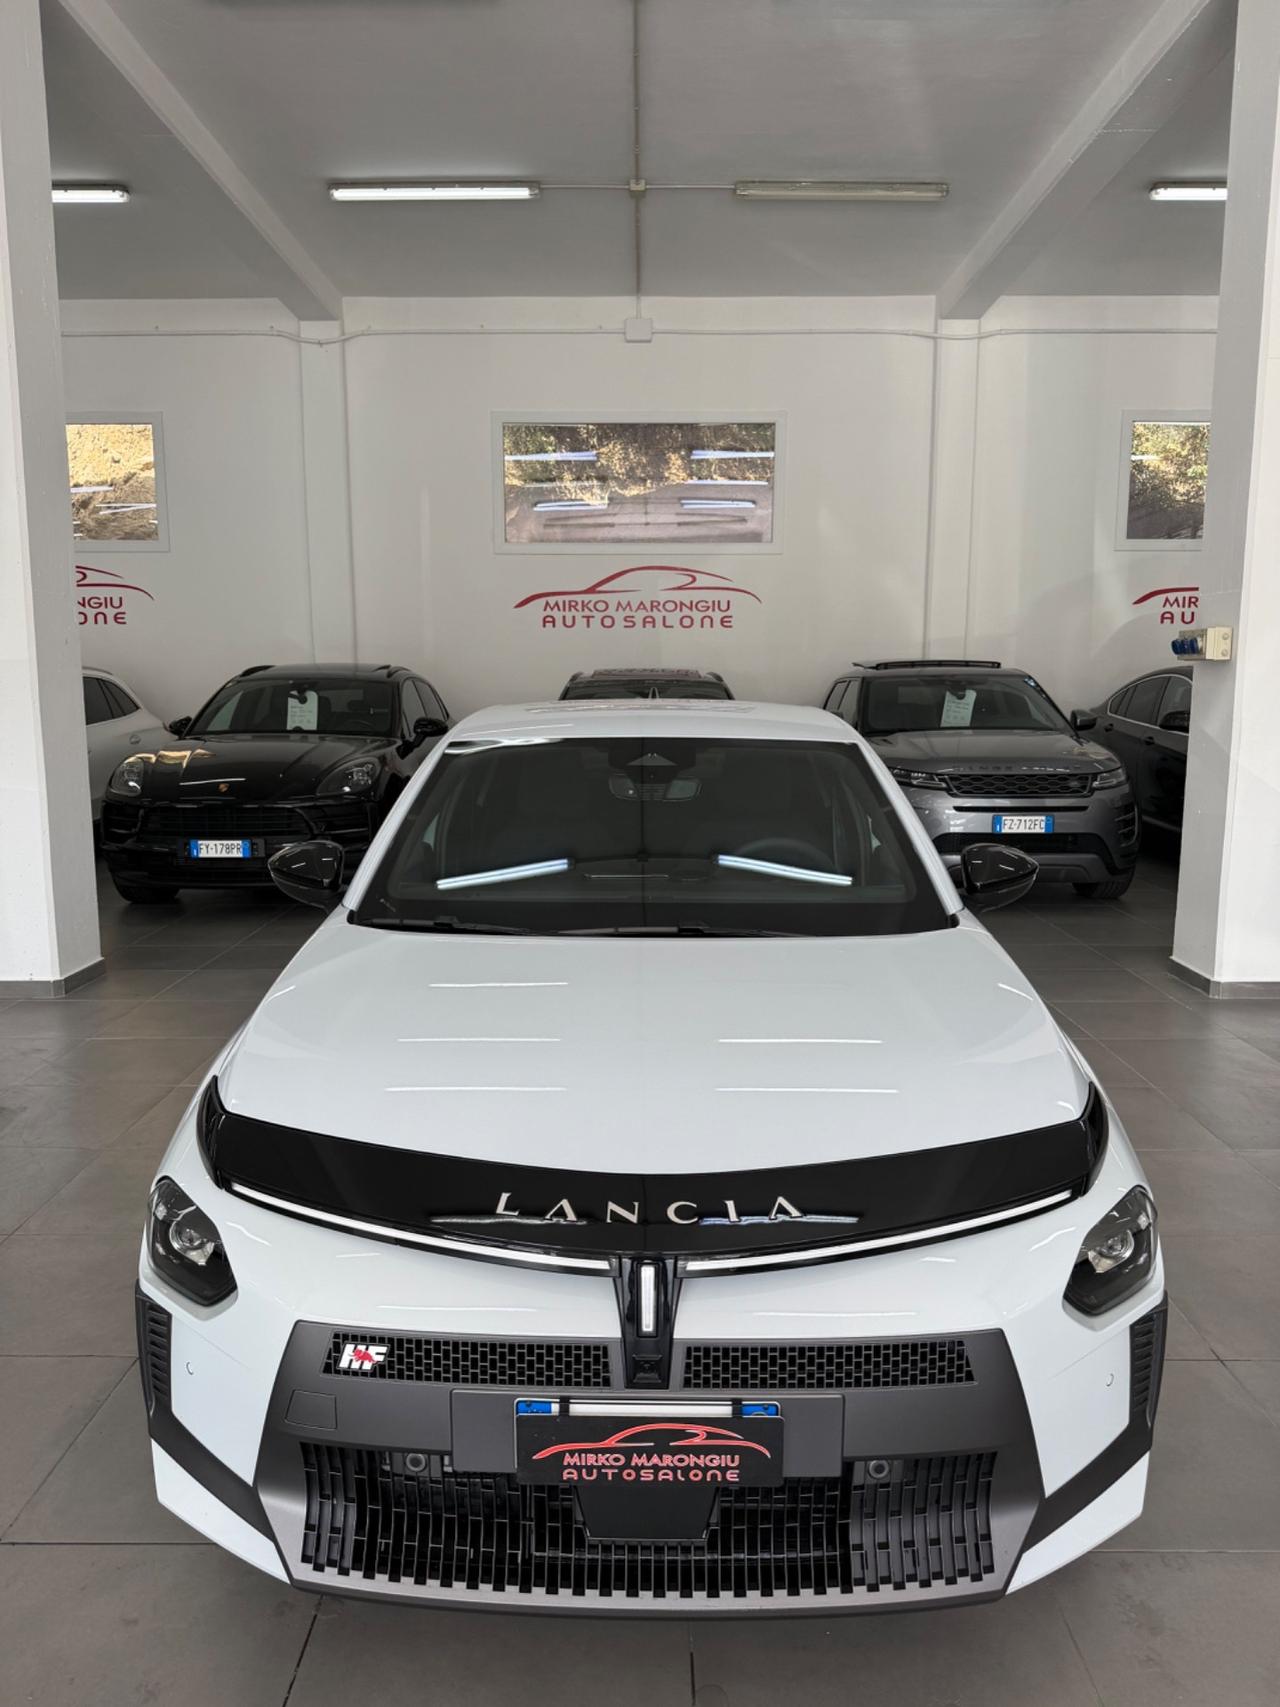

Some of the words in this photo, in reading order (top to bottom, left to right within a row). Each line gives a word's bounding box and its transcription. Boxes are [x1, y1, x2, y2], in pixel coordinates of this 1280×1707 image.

[543, 599, 609, 613] MIRKO
[615, 599, 731, 613] MARONGIU
[542, 614, 733, 629] AUTOSALONE
[495, 1191, 803, 1224] LANCIA
[339, 1343, 388, 1370] HF
[562, 1452, 626, 1467] MIRKO
[630, 1453, 741, 1468] MARONGIU
[562, 1468, 741, 1482] AUTOSALONE
